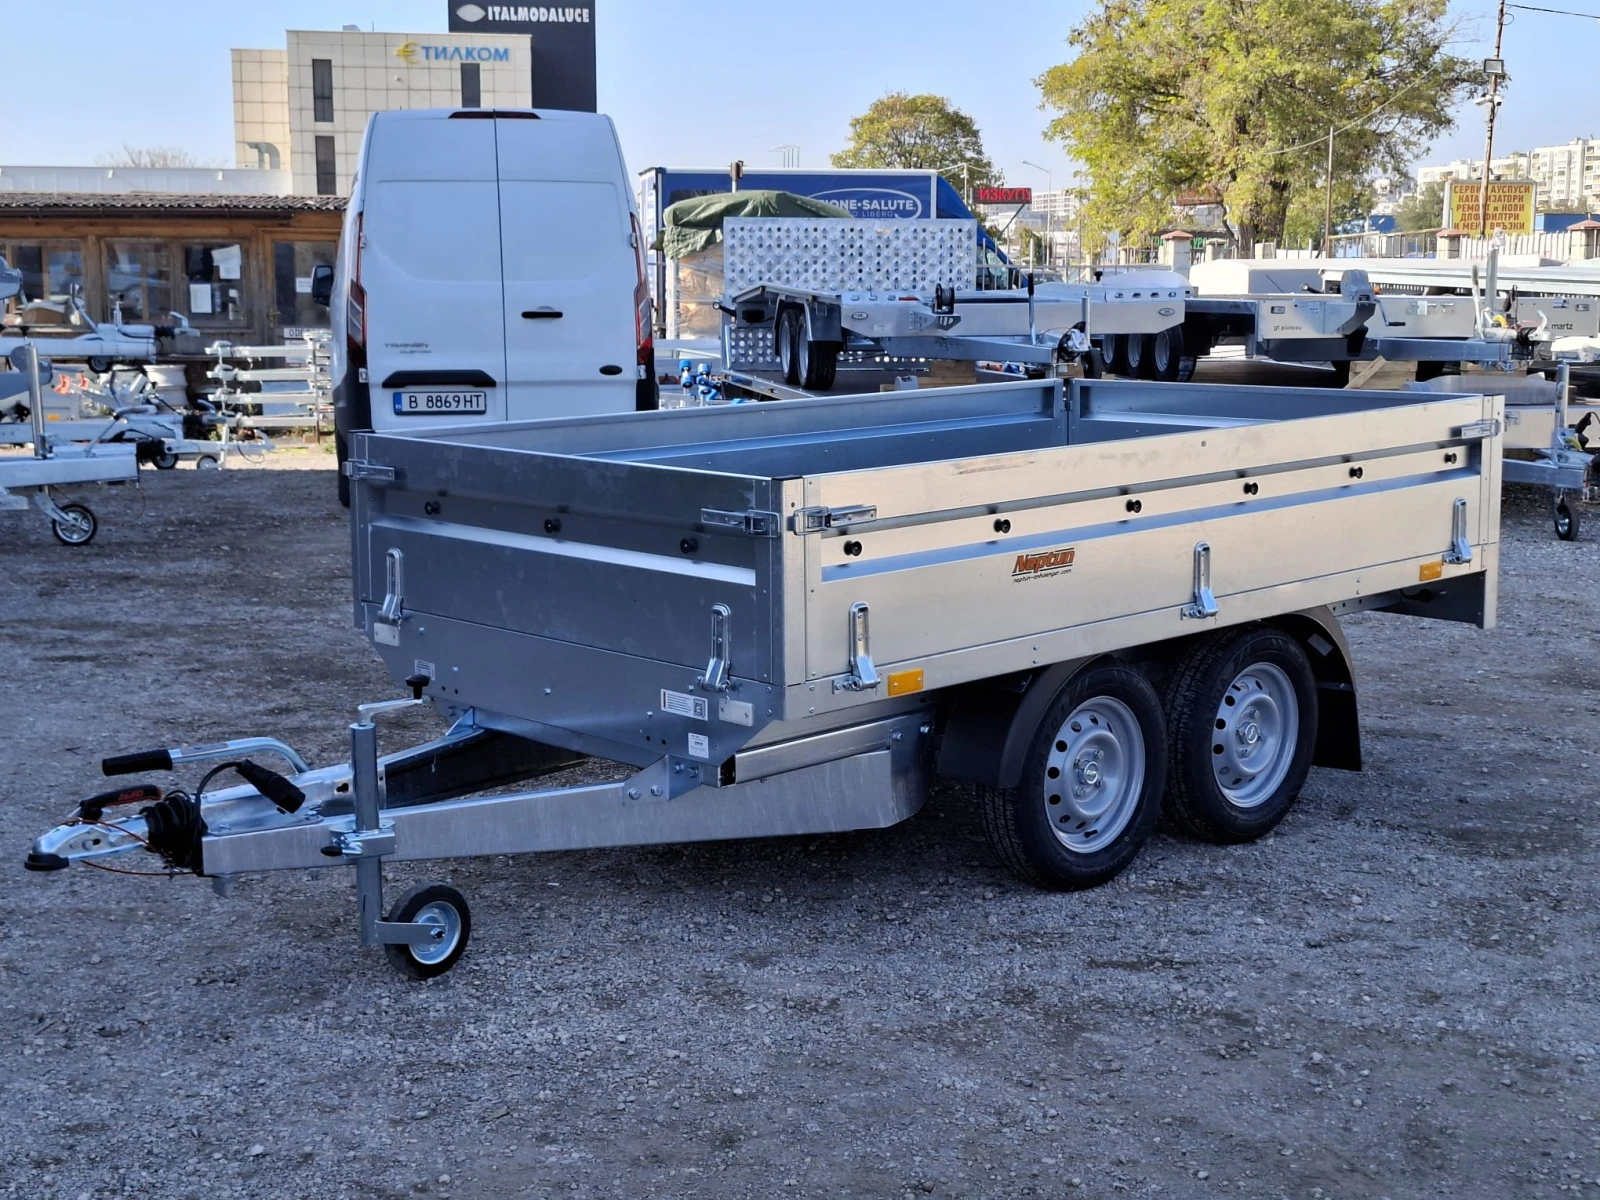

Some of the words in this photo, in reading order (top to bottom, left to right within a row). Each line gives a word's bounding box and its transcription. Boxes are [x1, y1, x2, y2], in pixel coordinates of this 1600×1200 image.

[487, 6, 590, 23] ITALMODALUCE
[1454, 185, 1481, 194] СЕРВИ
[1490, 185, 1530, 194] АУСПУСИ
[1458, 195, 1524, 203] КАТАИЗАТОРИ
[1456, 204, 1490, 212] РЕМОТ
[1501, 204, 1525, 212] НОВИ
[862, 210, 894, 218] LIBERO
[1462, 222, 1481, 230] МЕК
[1489, 222, 1525, 230] ВРЪЗКИ
[1012, 551, 1075, 573] Neptun
